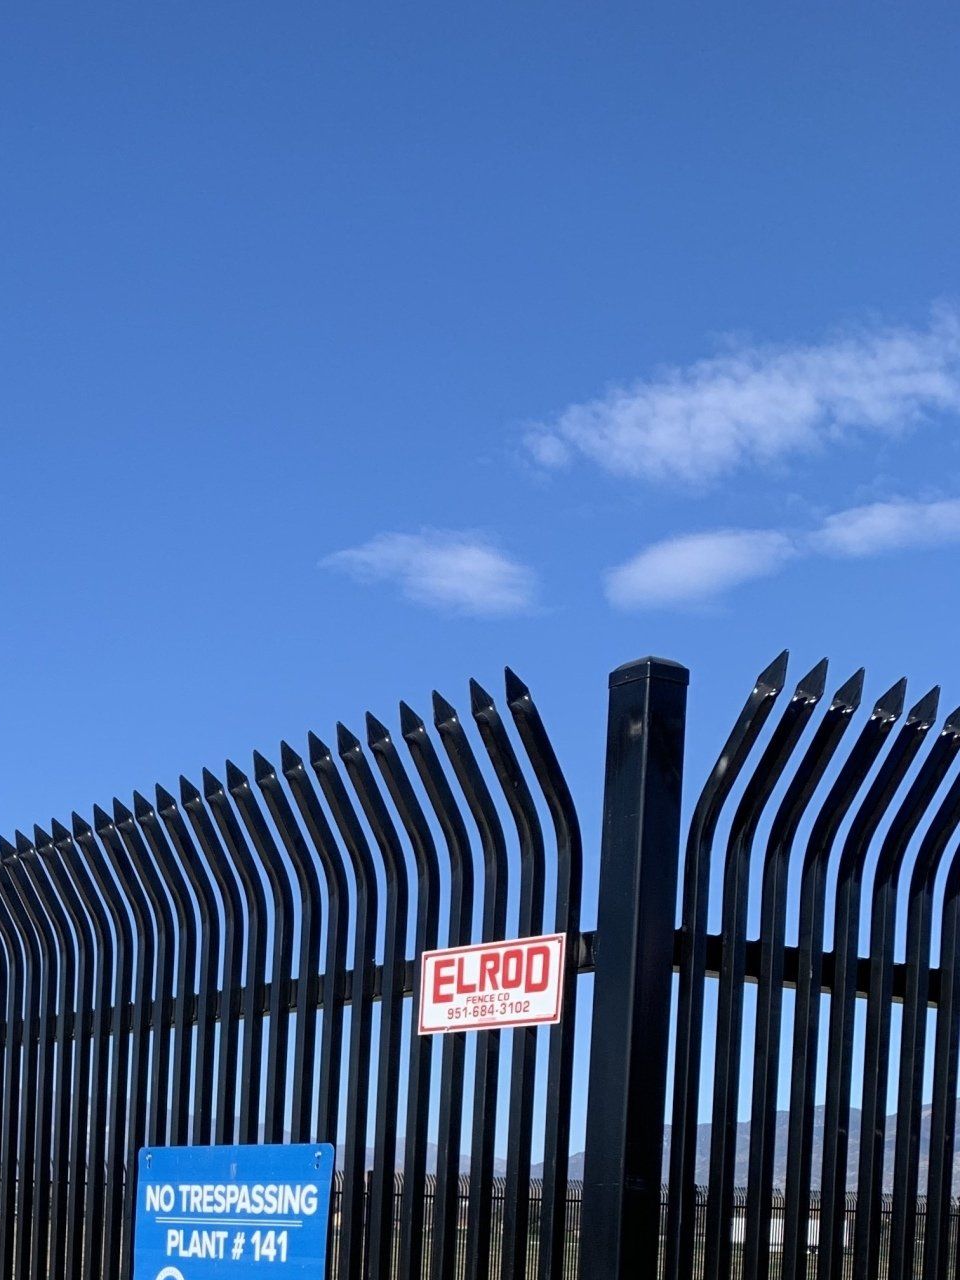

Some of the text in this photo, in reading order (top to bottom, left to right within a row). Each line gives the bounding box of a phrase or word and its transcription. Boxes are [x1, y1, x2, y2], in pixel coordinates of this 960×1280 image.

[432, 945, 550, 1004] ELROD
[466, 992, 510, 1005] FENCE CO
[145, 1184, 318, 1215] NO TRESPASSING
[166, 1229, 288, 1262] PLANT # 141
